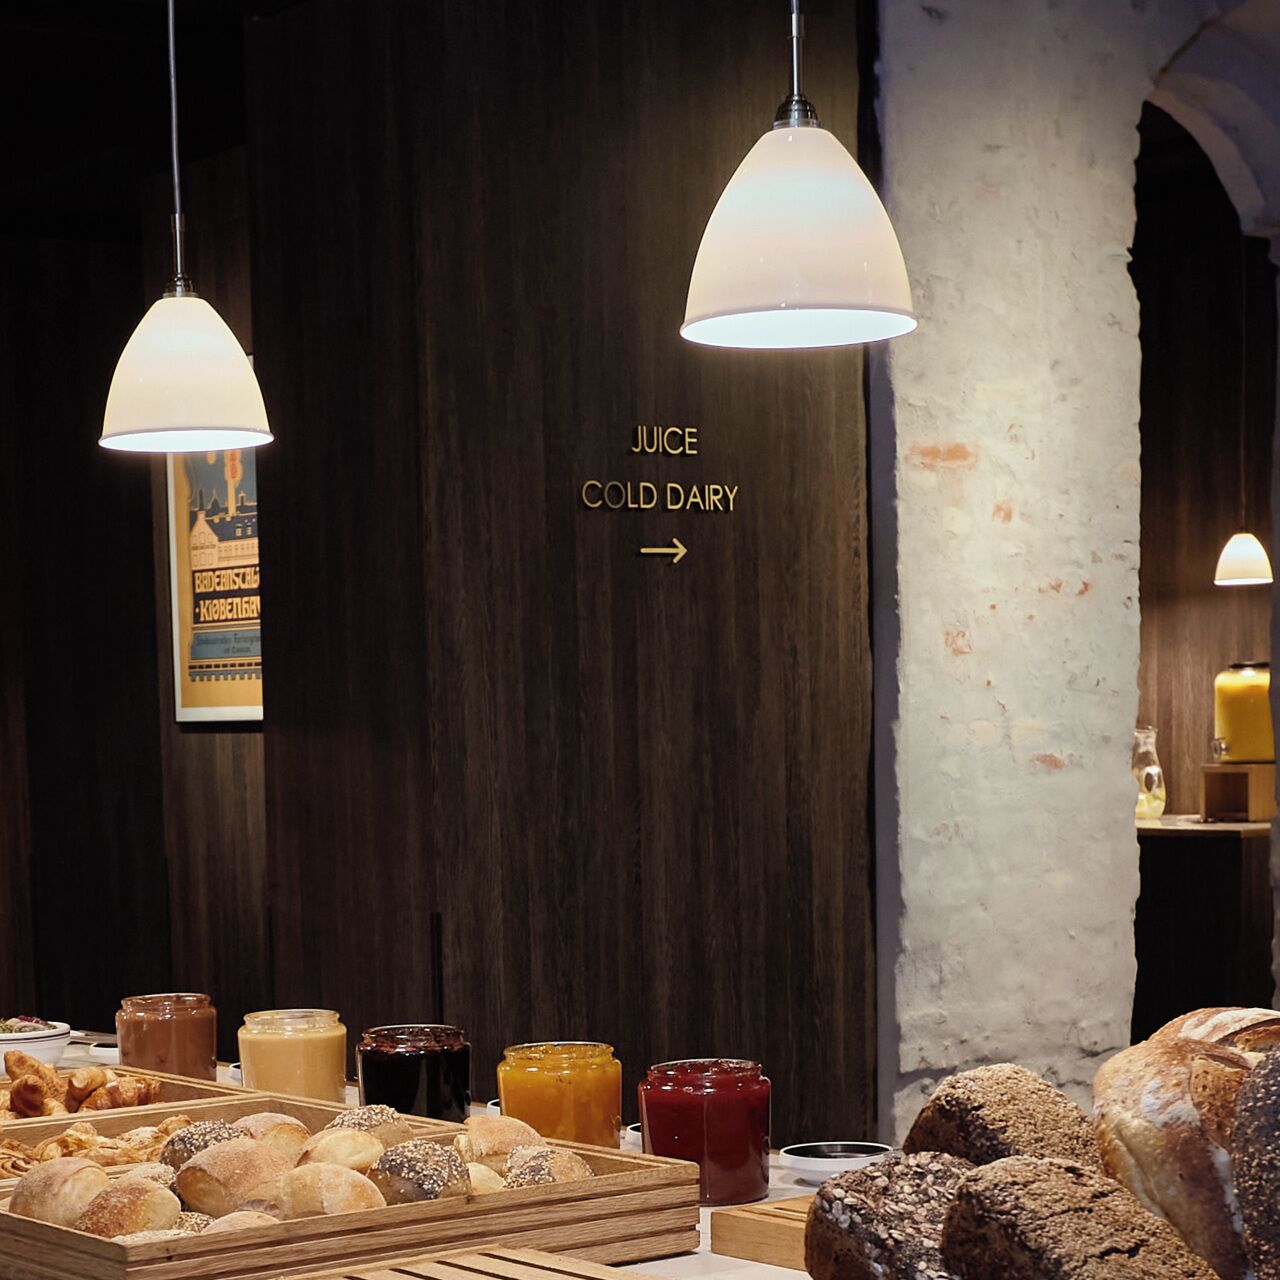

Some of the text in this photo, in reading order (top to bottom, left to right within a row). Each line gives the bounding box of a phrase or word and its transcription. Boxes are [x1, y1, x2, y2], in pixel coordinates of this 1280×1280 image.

[632, 425, 698, 454] JUICE
[582, 480, 738, 511] COLD DAIRY
